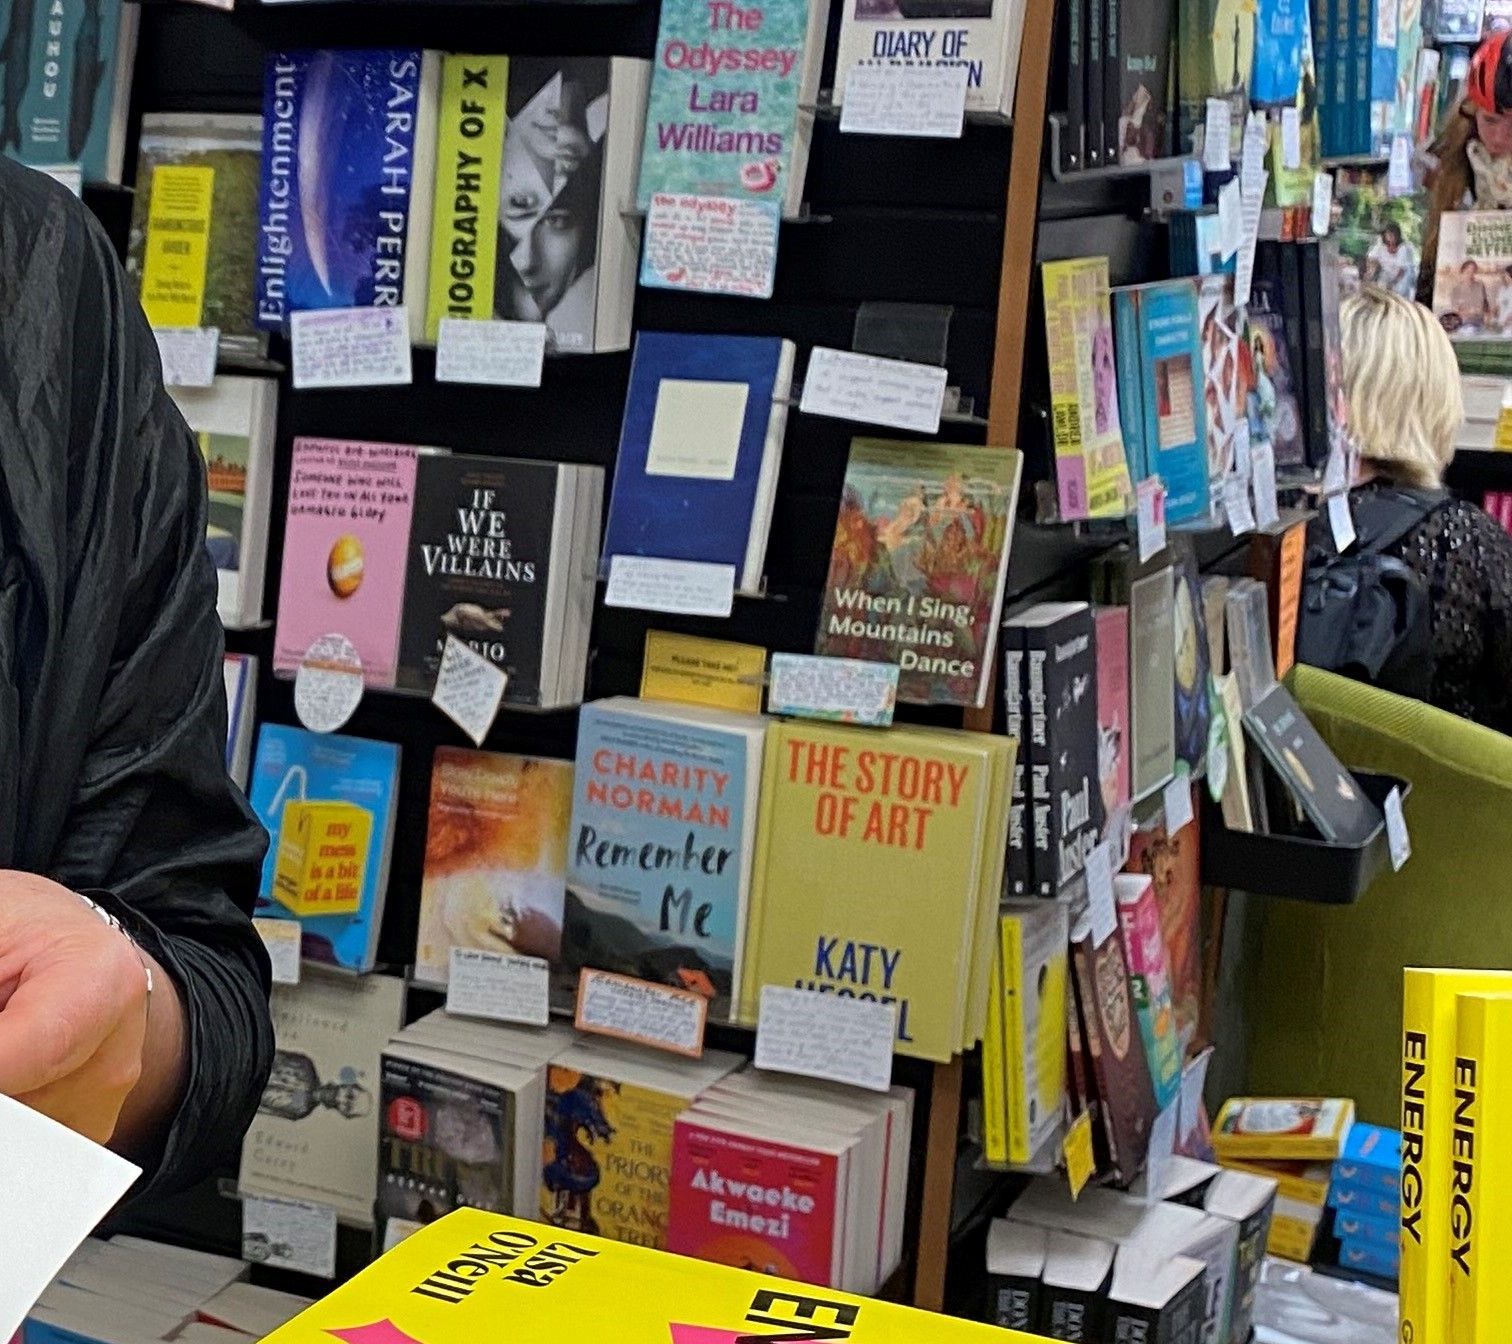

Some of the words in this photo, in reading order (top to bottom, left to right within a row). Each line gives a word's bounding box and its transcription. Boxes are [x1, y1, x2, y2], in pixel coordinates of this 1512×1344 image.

[705, 0, 764, 32] The
[661, 38, 798, 78] Odyssey
[872, 30, 934, 57] DIARY
[941, 29, 969, 57] OF
[463, 66, 489, 90] X
[688, 83, 758, 113] Lara
[379, 57, 418, 196] SARAH
[459, 98, 486, 139] OF
[656, 122, 784, 155] Williams
[259, 61, 296, 322] Enlightenment
[372, 209, 405, 307] PERR
[472, 488, 496, 509] IF
[457, 507, 507, 539] WE
[420, 543, 537, 584] VILLAINS
[446, 533, 512, 559] WERE
[834, 588, 907, 616] When
[907, 598, 916, 616] I
[919, 596, 976, 625] Sing,
[828, 612, 955, 648] Mountains
[899, 651, 976, 678] Dance
[592, 749, 730, 796] CHARITY
[787, 739, 851, 791] THE
[855, 748, 970, 808] STORY
[586, 780, 731, 831] NORMAN
[814, 791, 859, 841] OF
[862, 800, 934, 851] ART
[575, 824, 735, 876] Remember
[659, 885, 714, 938] Me
[814, 936, 902, 990] KATY
[1400, 1030, 1427, 1246] ENERGY
[1449, 1056, 1477, 1278] ENERGY
[690, 1167, 815, 1214] Akwaeke
[708, 1200, 791, 1239] Emezi
[410, 1230, 539, 1305] O'Neill
[524, 1240, 600, 1289] Lisa
